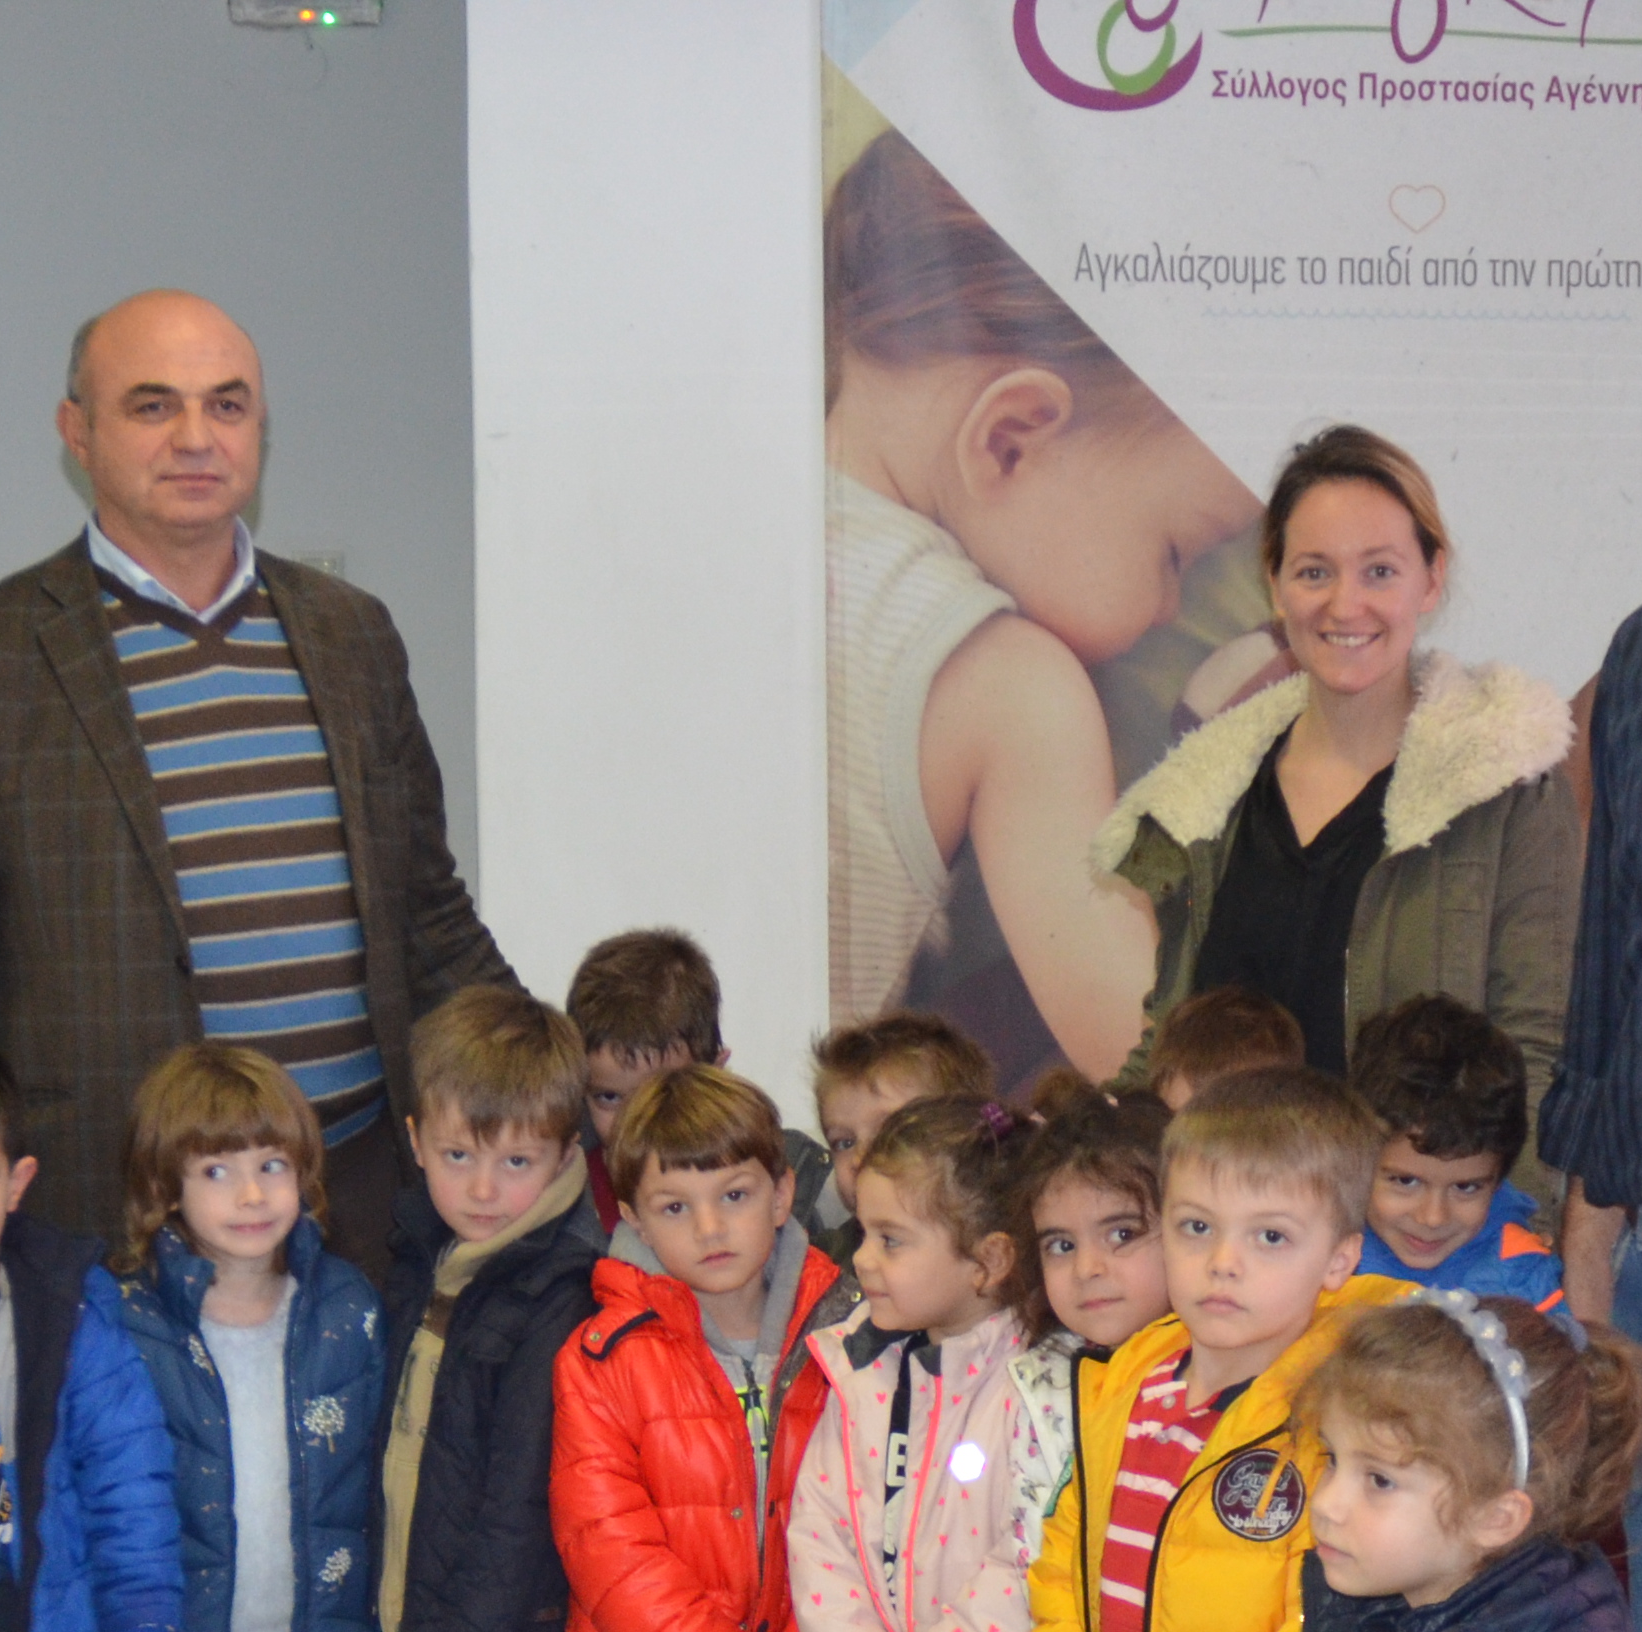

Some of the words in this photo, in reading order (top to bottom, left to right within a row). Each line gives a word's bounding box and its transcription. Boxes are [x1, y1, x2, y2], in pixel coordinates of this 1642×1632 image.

[1211, 68, 1347, 106] Σύλλογος
[1358, 73, 1535, 109] Προστασίας
[1074, 242, 1286, 294] Αγκαλιάζουμε
[1296, 256, 1327, 285] το
[1338, 245, 1413, 287] παιδί
[1422, 246, 1478, 288] από
[1489, 258, 1537, 288] την
[1547, 247, 1642, 298] πρώτη
